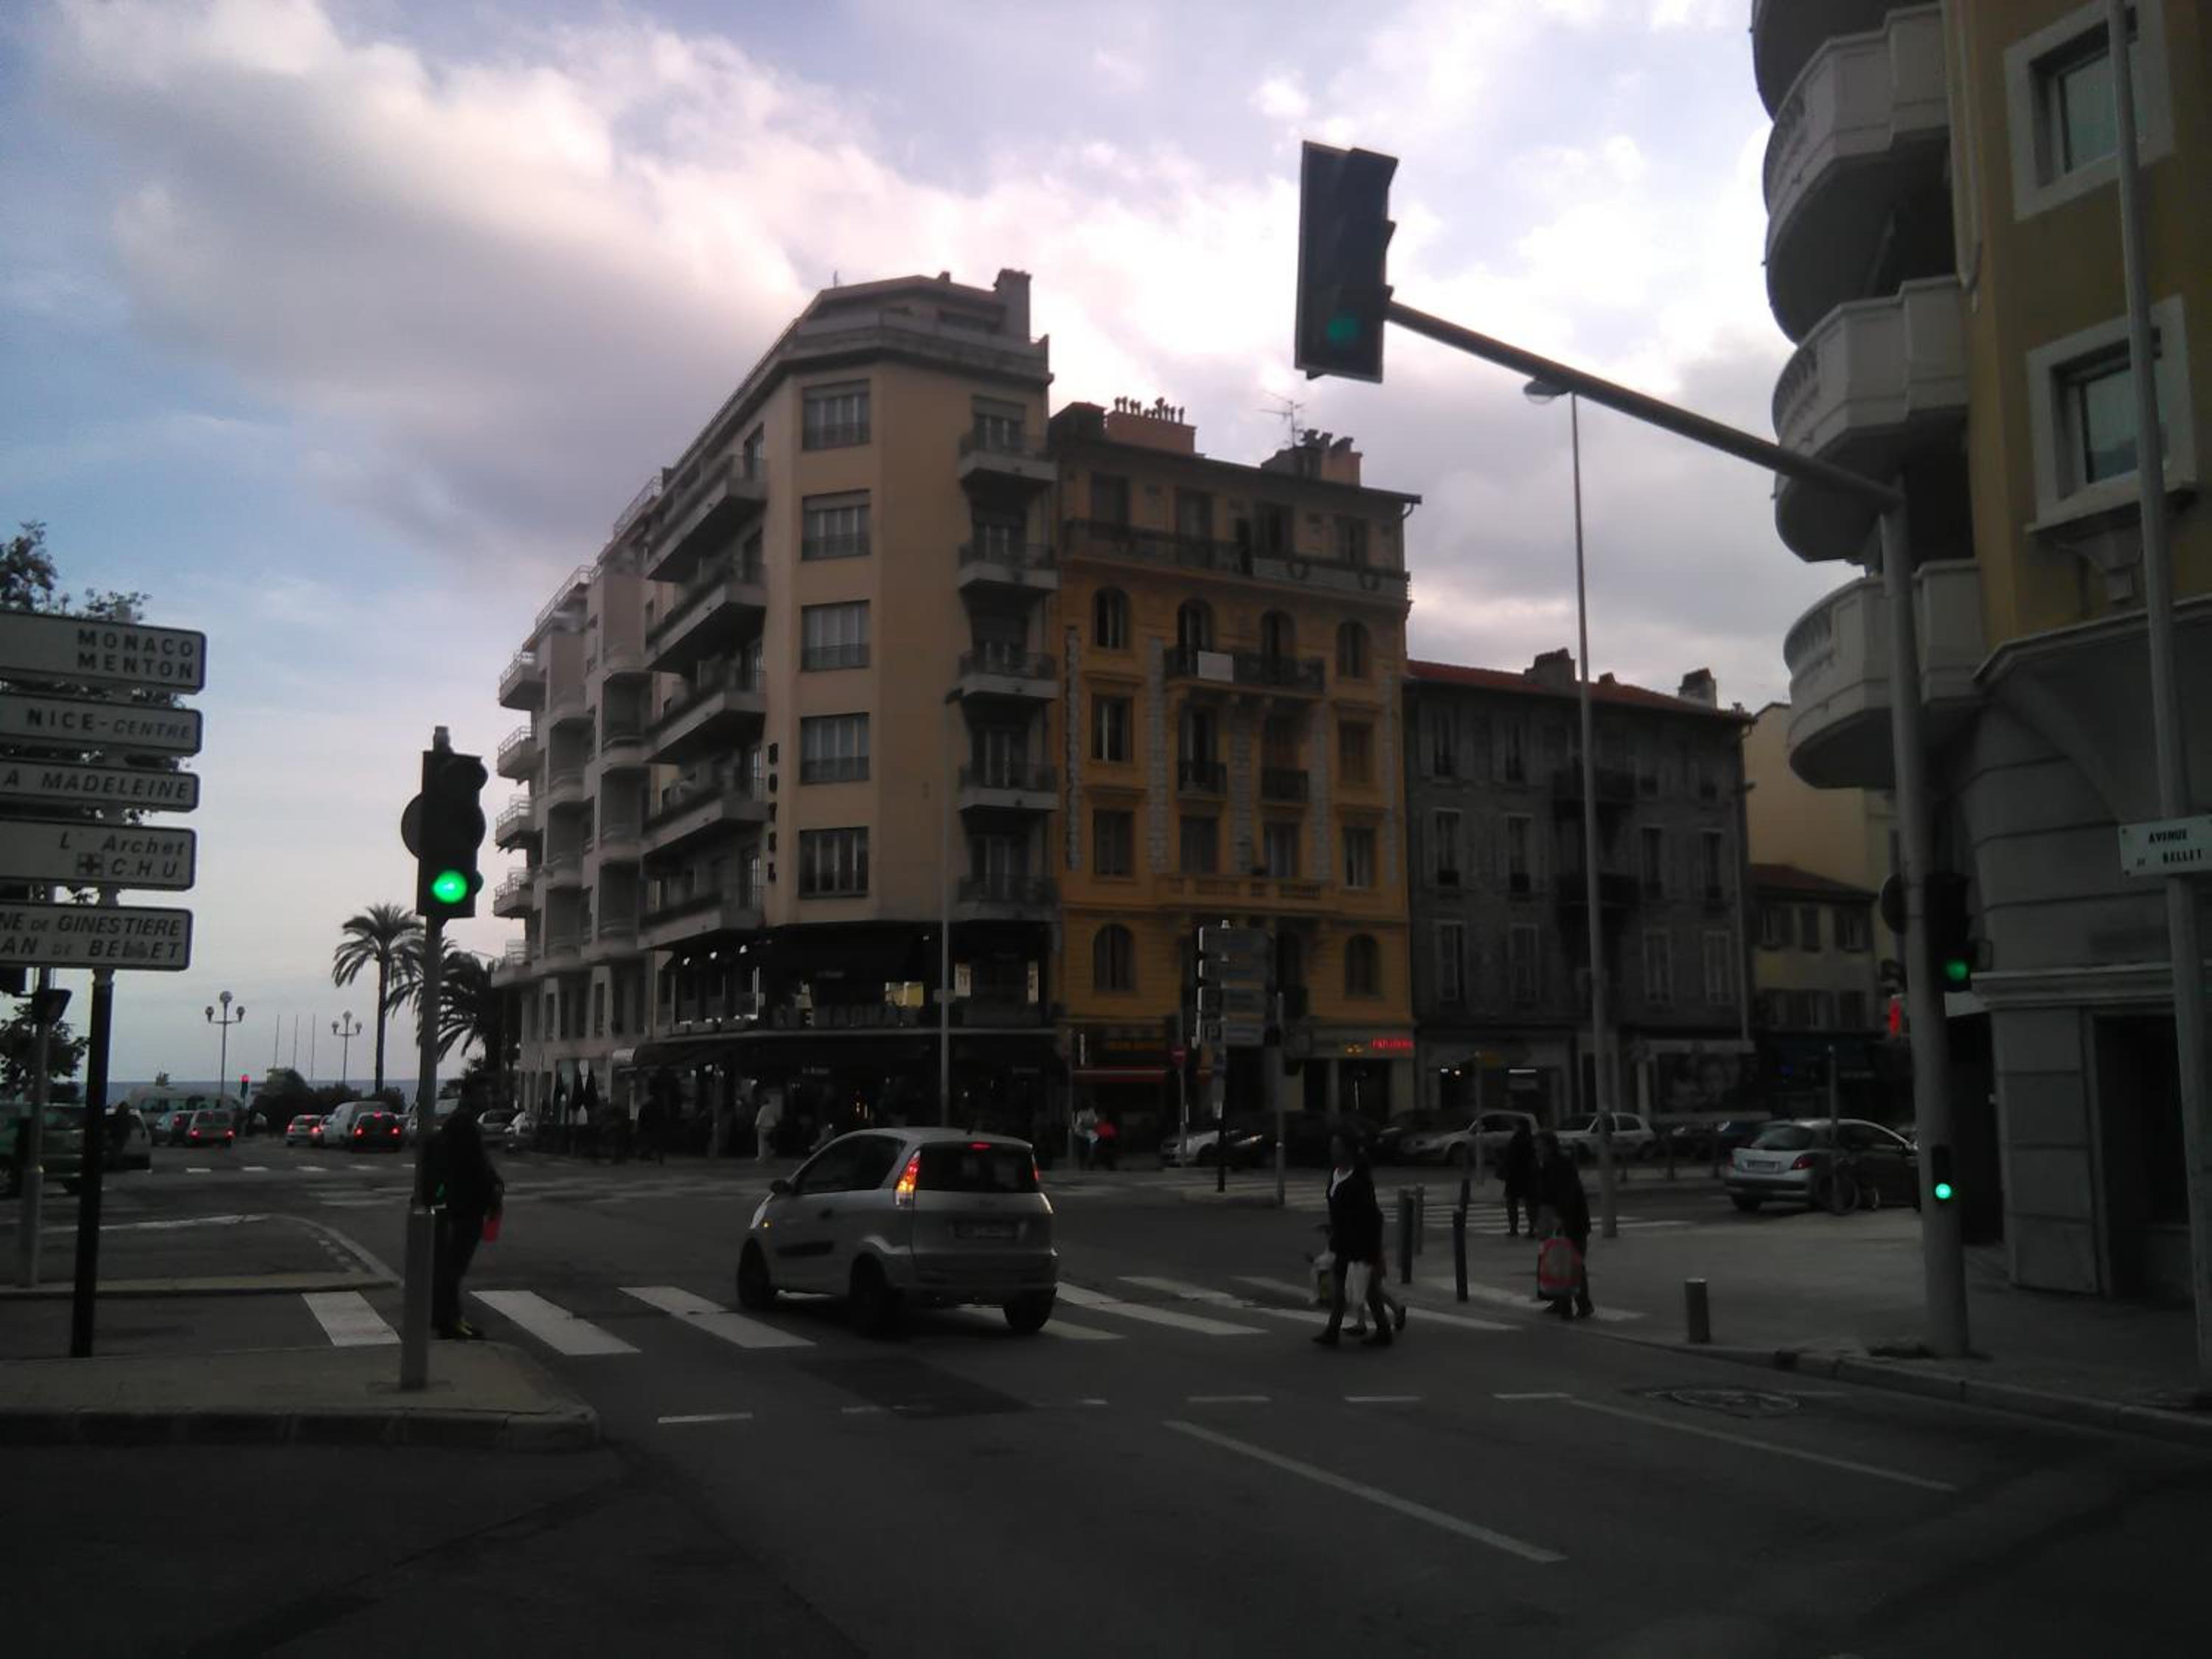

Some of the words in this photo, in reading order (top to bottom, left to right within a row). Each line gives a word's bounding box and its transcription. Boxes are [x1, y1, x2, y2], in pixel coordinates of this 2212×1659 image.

[77, 628, 194, 658] MONACO
[77, 652, 192, 680] MENTON
[41, 771, 189, 799] MADELEINE
[101, 835, 185, 856] Archet
[58, 914, 181, 937] GINESTIERE
[0, 936, 38, 955] AN
